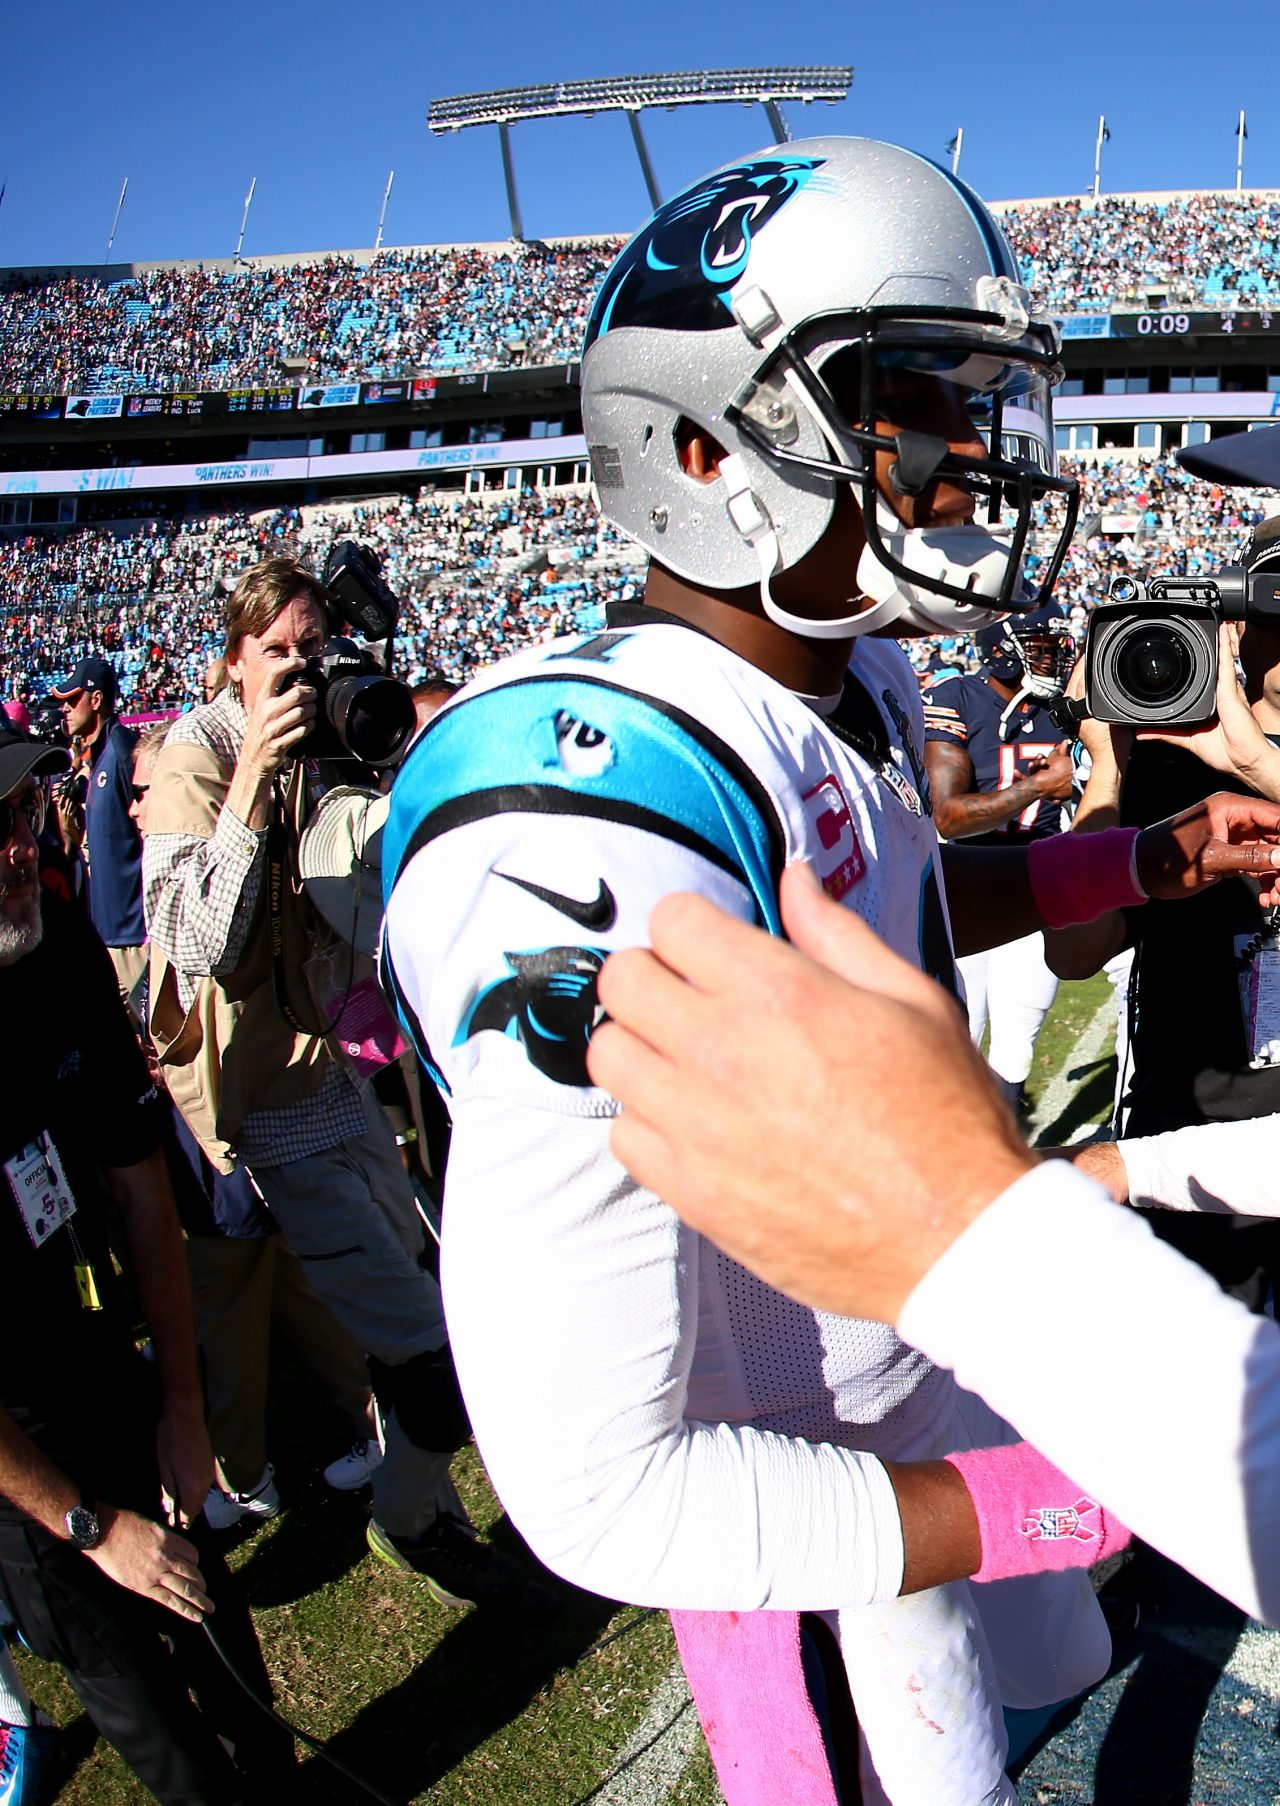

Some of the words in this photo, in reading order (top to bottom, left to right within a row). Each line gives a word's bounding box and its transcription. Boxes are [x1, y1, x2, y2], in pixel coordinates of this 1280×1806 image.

[1137, 315, 1189, 334] 0:09
[1221, 320, 1233, 334] 4
[1262, 320, 1270, 329] 3
[418, 448, 473, 465] PANTHERS
[195, 464, 247, 481] PANTHERS
[250, 464, 275, 477] WIN!
[338, 656, 361, 665] Nikon
[97, 771, 107, 788] C
[998, 743, 1058, 834] 17
[271, 862, 281, 912] Nikon
[24, 1163, 47, 1187] OFFICIA
